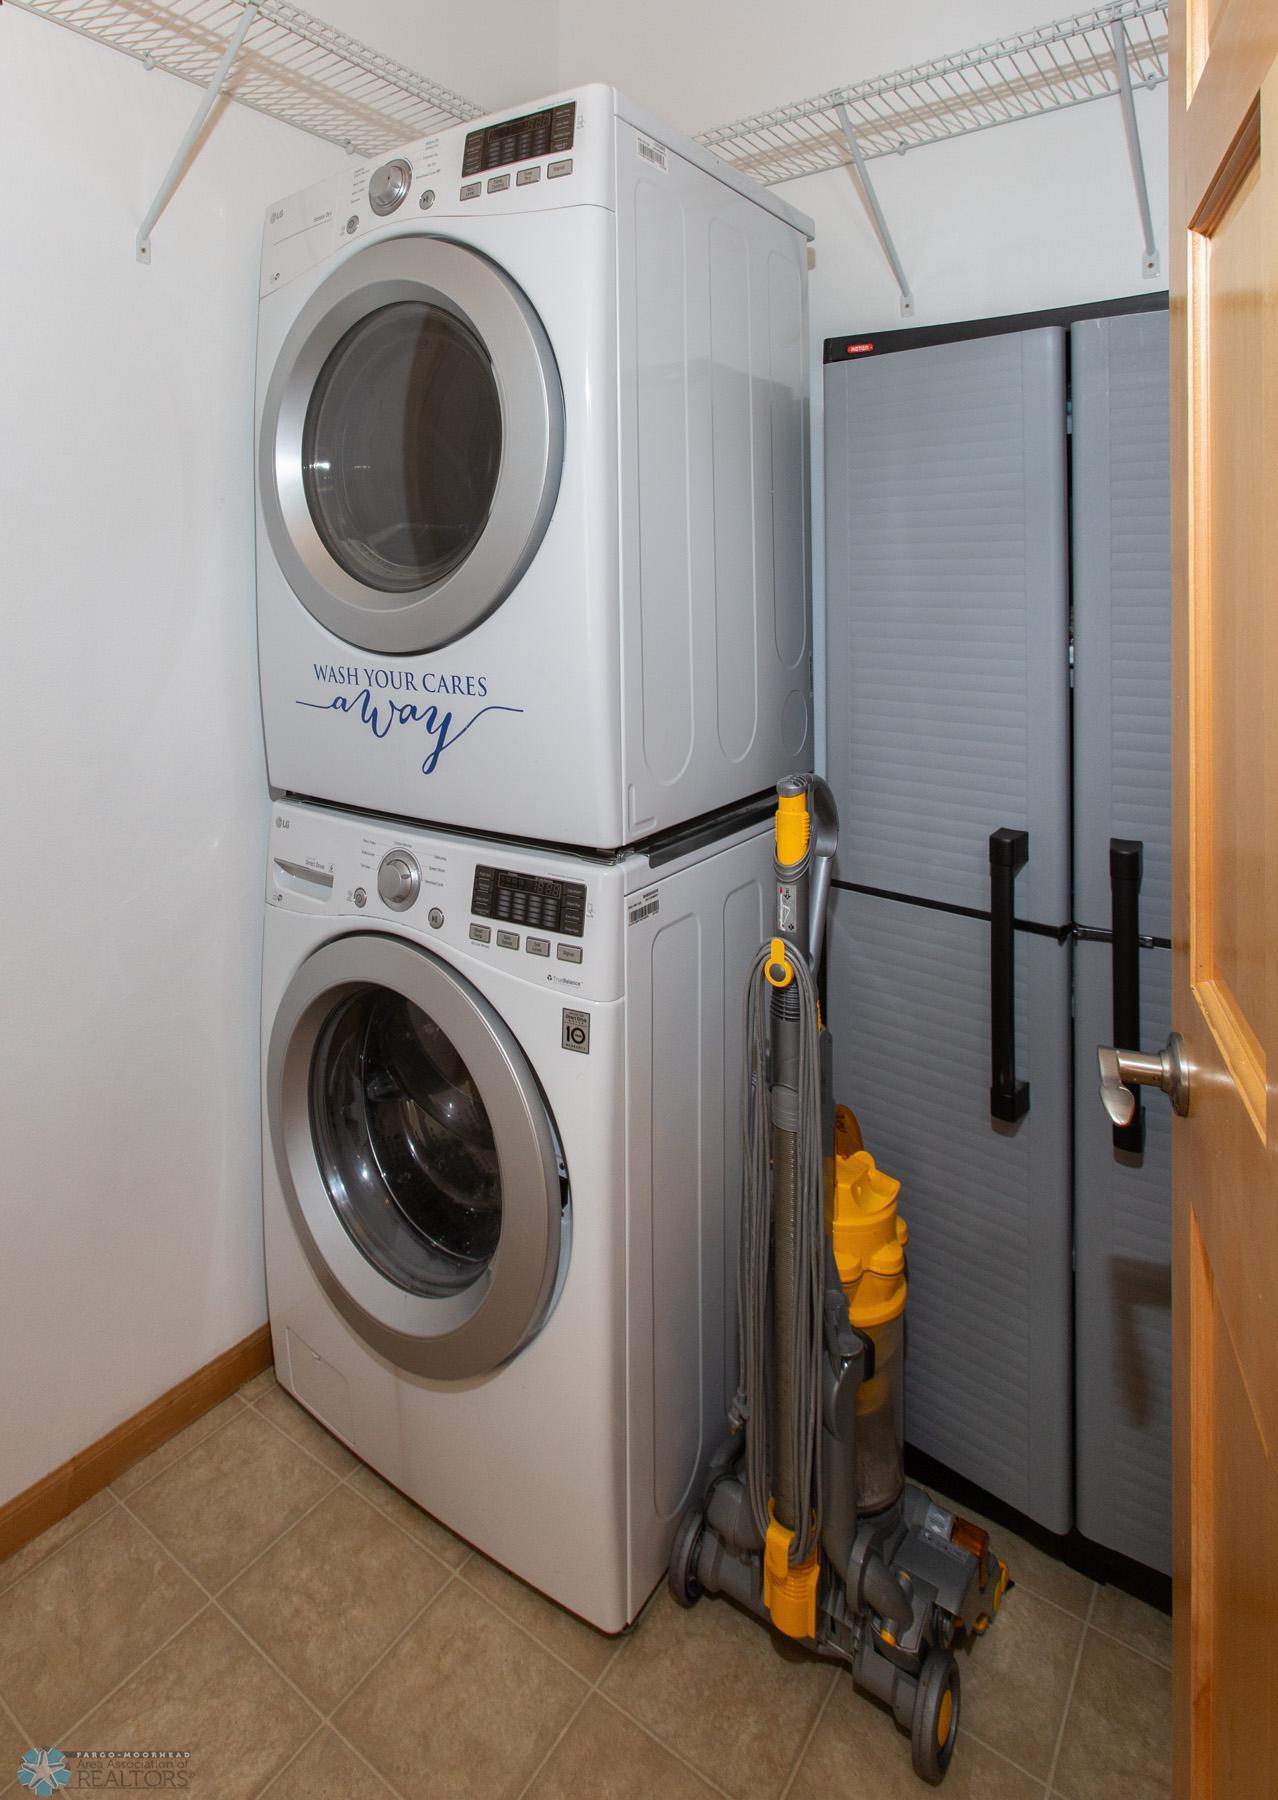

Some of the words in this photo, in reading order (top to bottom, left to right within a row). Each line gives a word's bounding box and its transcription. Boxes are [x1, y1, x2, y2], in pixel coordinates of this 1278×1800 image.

[313, 663, 360, 686] WASH
[363, 668, 418, 691] YOUR
[422, 673, 488, 697] CARES
[282, 819, 291, 829] LG
[566, 1025, 586, 1045] 10
